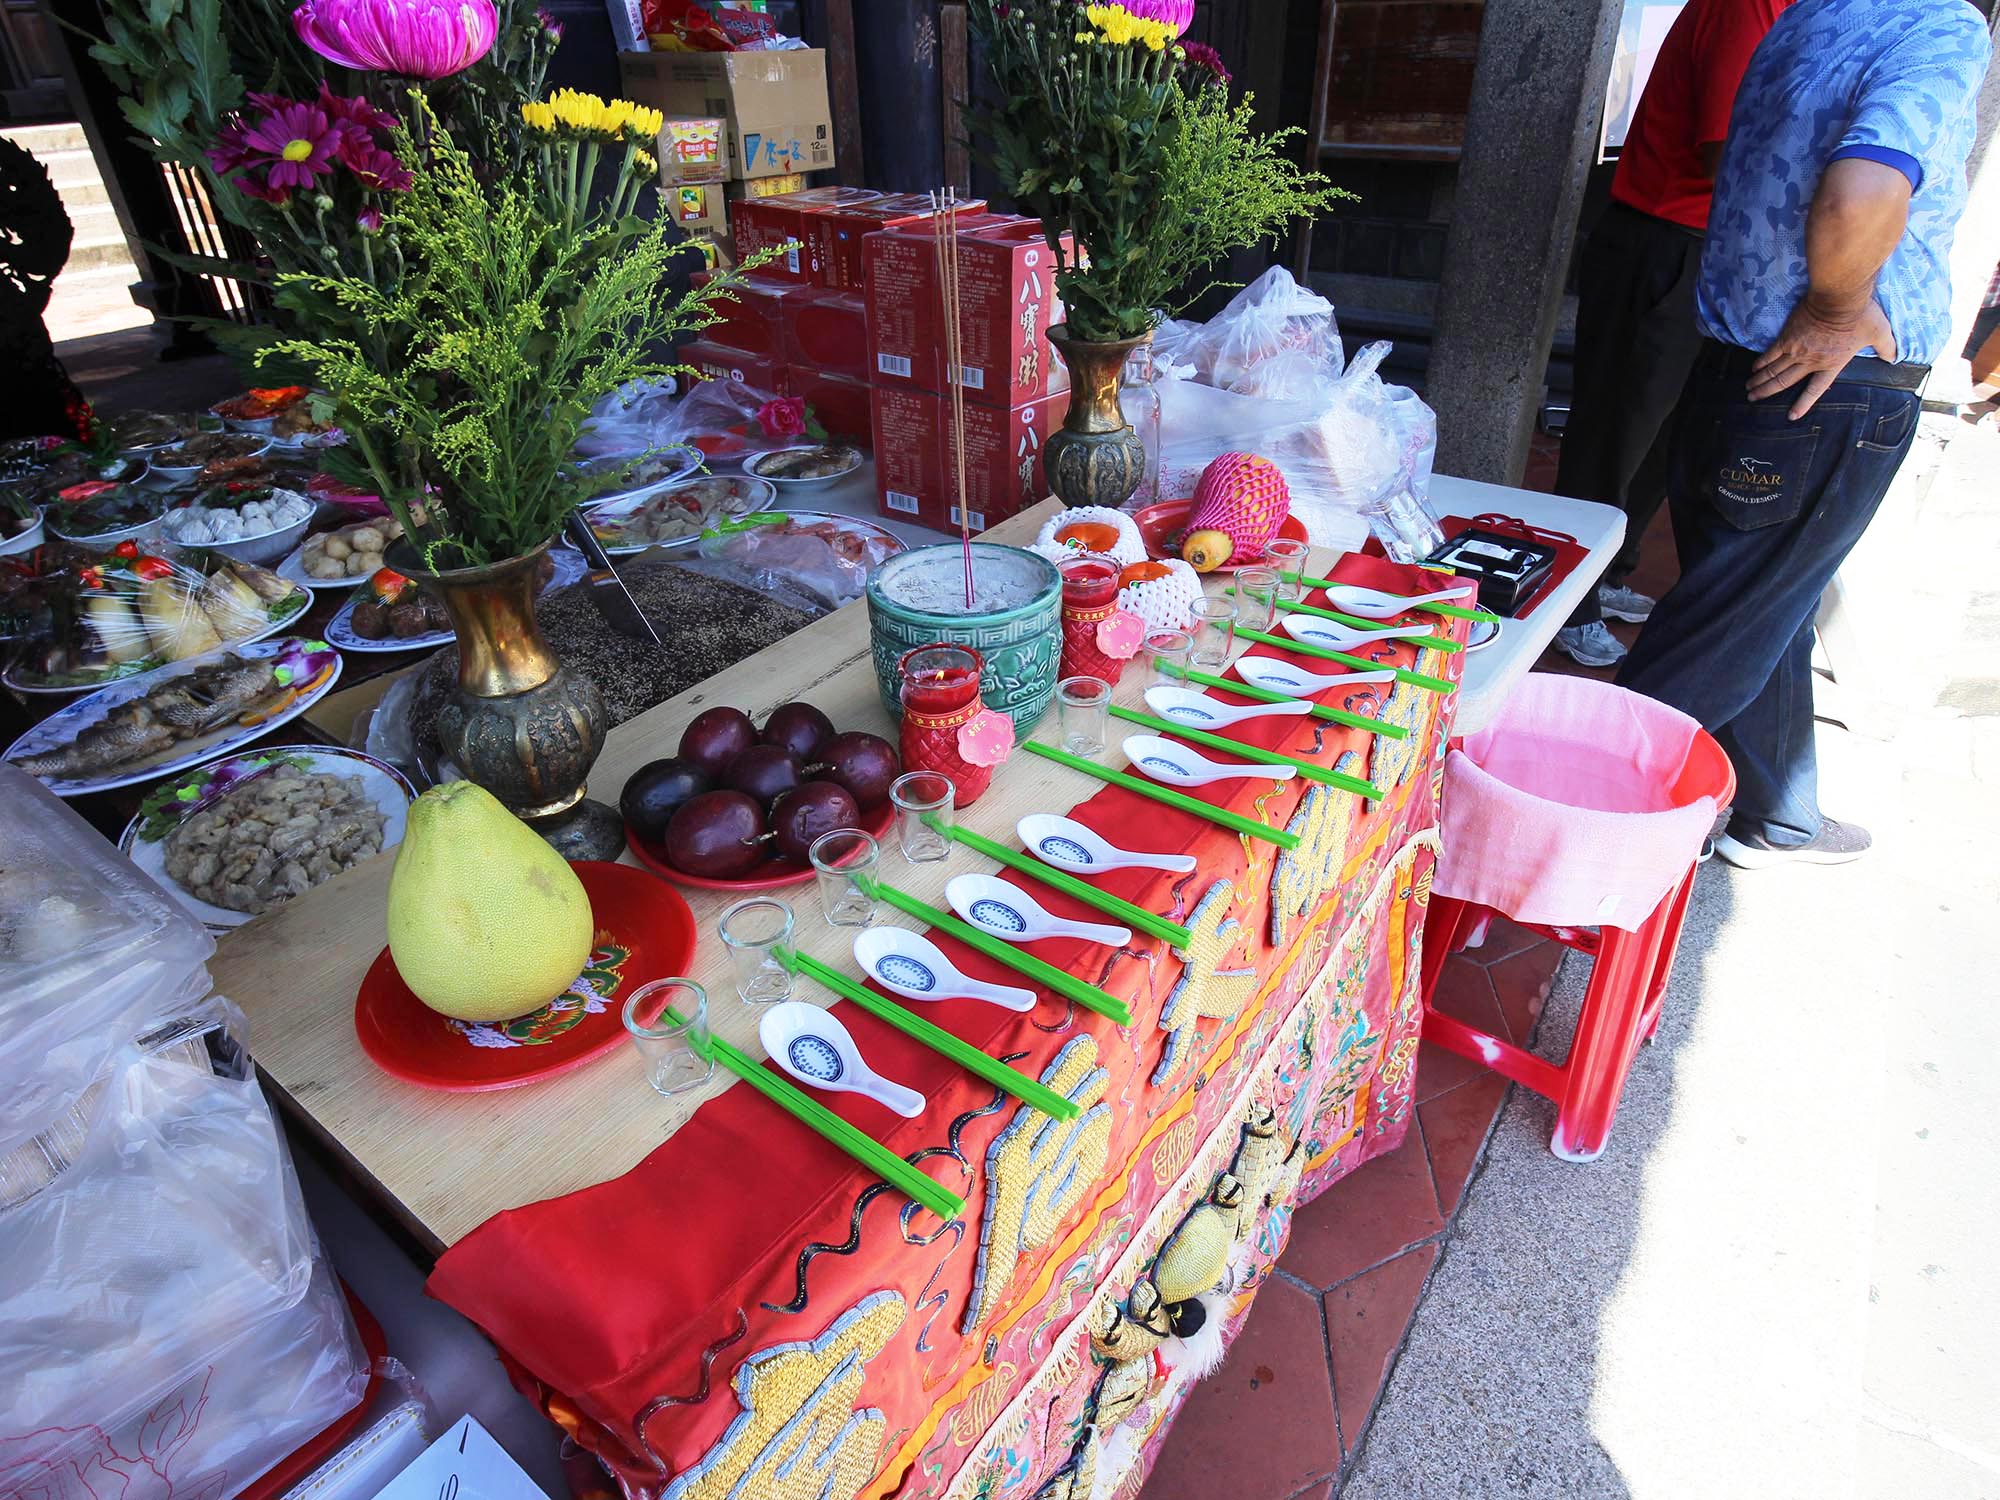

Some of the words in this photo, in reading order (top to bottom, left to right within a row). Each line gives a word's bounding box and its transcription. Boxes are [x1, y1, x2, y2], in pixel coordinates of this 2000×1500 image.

[1018, 270, 1043, 396] 八寶粥
[1720, 468, 1784, 486] CUMAR
[1718, 485, 1751, 504] ORIGINAL
